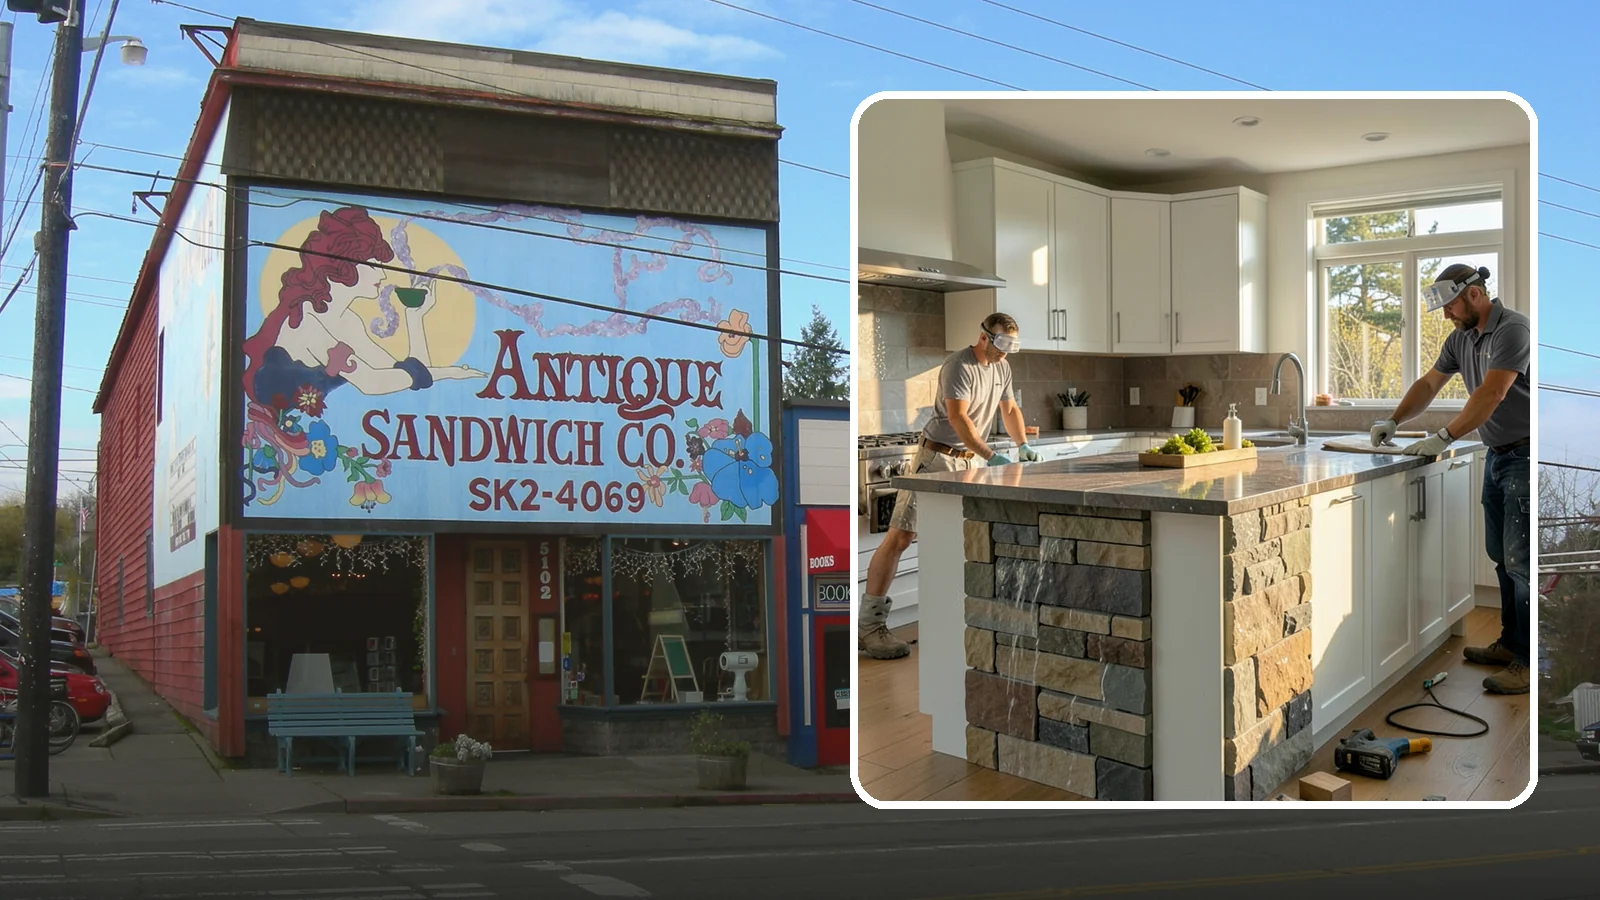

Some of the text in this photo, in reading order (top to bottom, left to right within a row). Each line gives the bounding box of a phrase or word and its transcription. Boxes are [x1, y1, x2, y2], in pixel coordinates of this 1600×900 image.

[477, 329, 723, 420] ANTIQUE
[361, 409, 685, 468] SANDWICH CO.
[468, 478, 645, 512] SK2-4069
[540, 541, 551, 600] 5102
[810, 556, 834, 568] BOOKS
